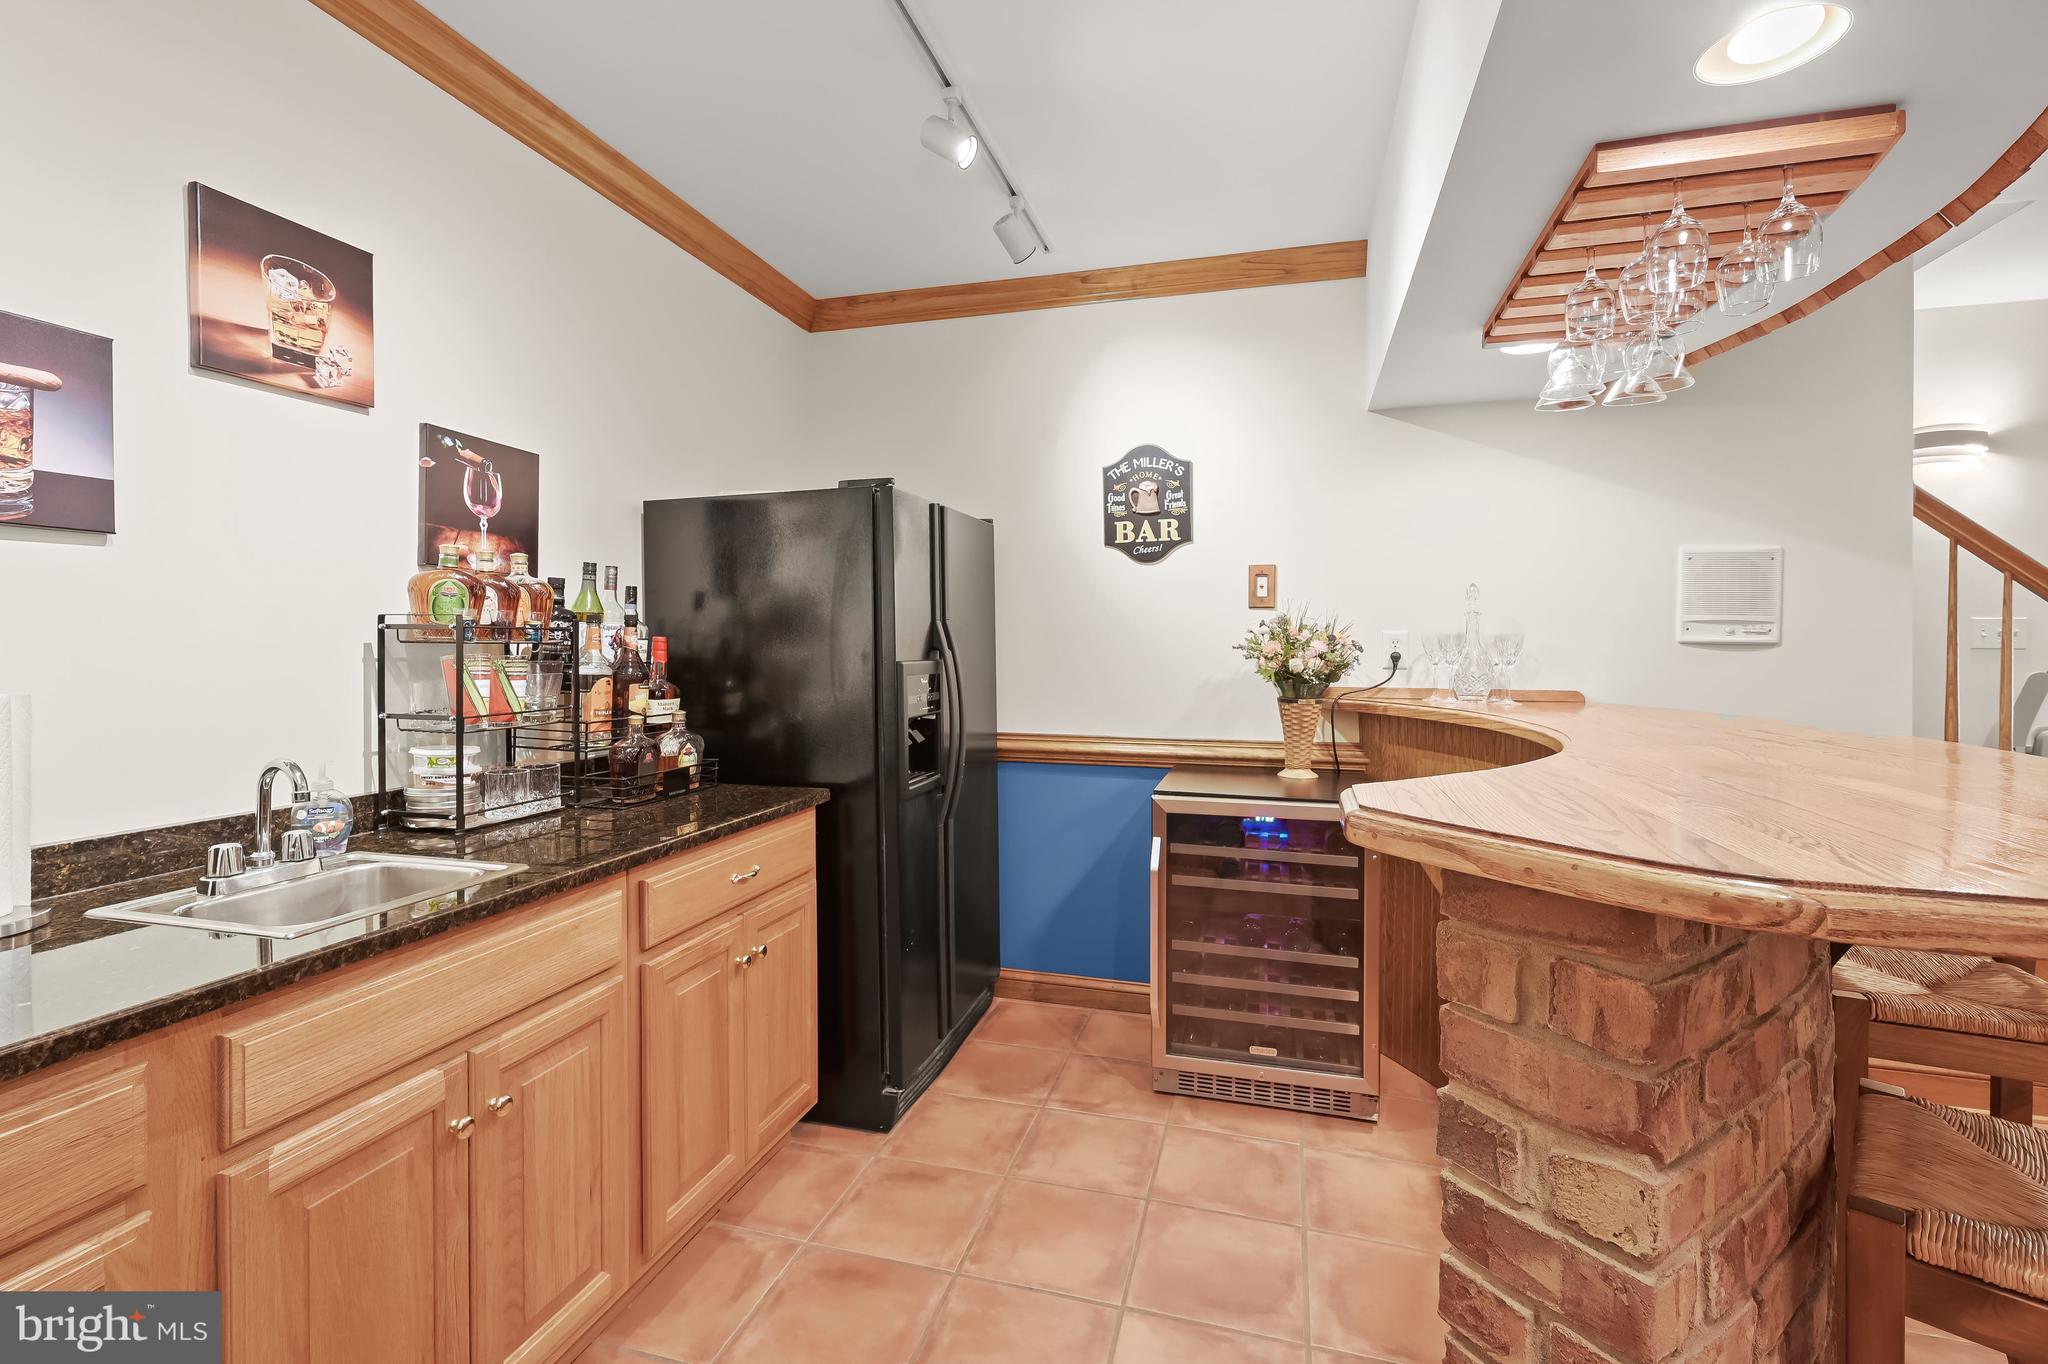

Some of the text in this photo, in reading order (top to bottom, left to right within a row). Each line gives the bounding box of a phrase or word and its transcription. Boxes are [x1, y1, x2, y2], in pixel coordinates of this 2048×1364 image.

[1107, 457, 1185, 480] THE MILLER'S
[1132, 471, 1160, 482] HOME
[1108, 493, 1125, 503] Good
[1166, 490, 1184, 500] Great
[1107, 503, 1125, 513] Times
[1165, 500, 1186, 510] Friends
[1114, 519, 1181, 543] BAR
[1133, 544, 1162, 554] Cheers!
